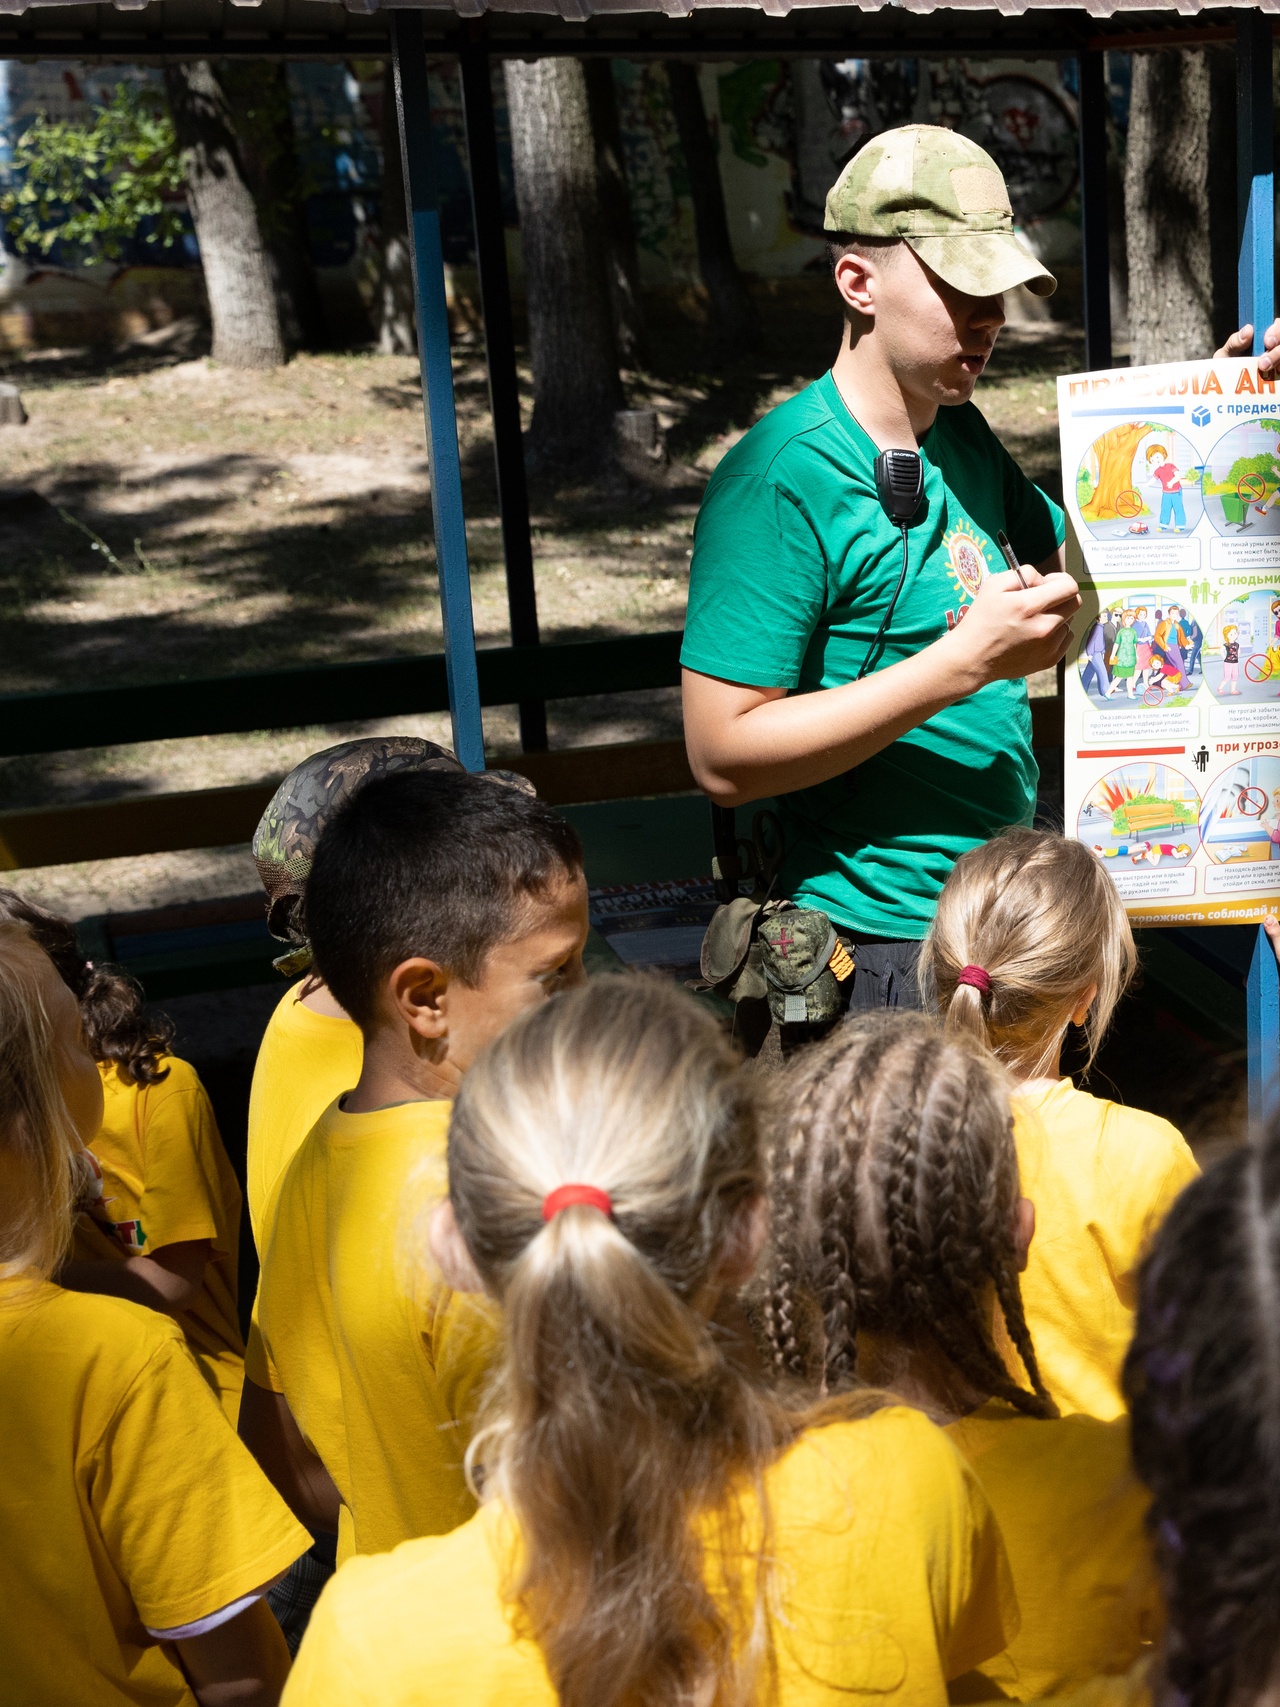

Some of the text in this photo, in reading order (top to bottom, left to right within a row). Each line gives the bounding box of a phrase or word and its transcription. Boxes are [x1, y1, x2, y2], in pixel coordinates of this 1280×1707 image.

[1069, 369, 1222, 397] ПРИЛА
[1217, 405, 1223, 414] с
[1218, 577, 1225, 585] с
[1216, 742, 1240, 754] при
[595, 888, 687, 907] ПРОТИВ
[1127, 911, 1205, 924] сторожность
[1207, 904, 1268, 920] соблюдай
[1270, 905, 1278, 915] и
